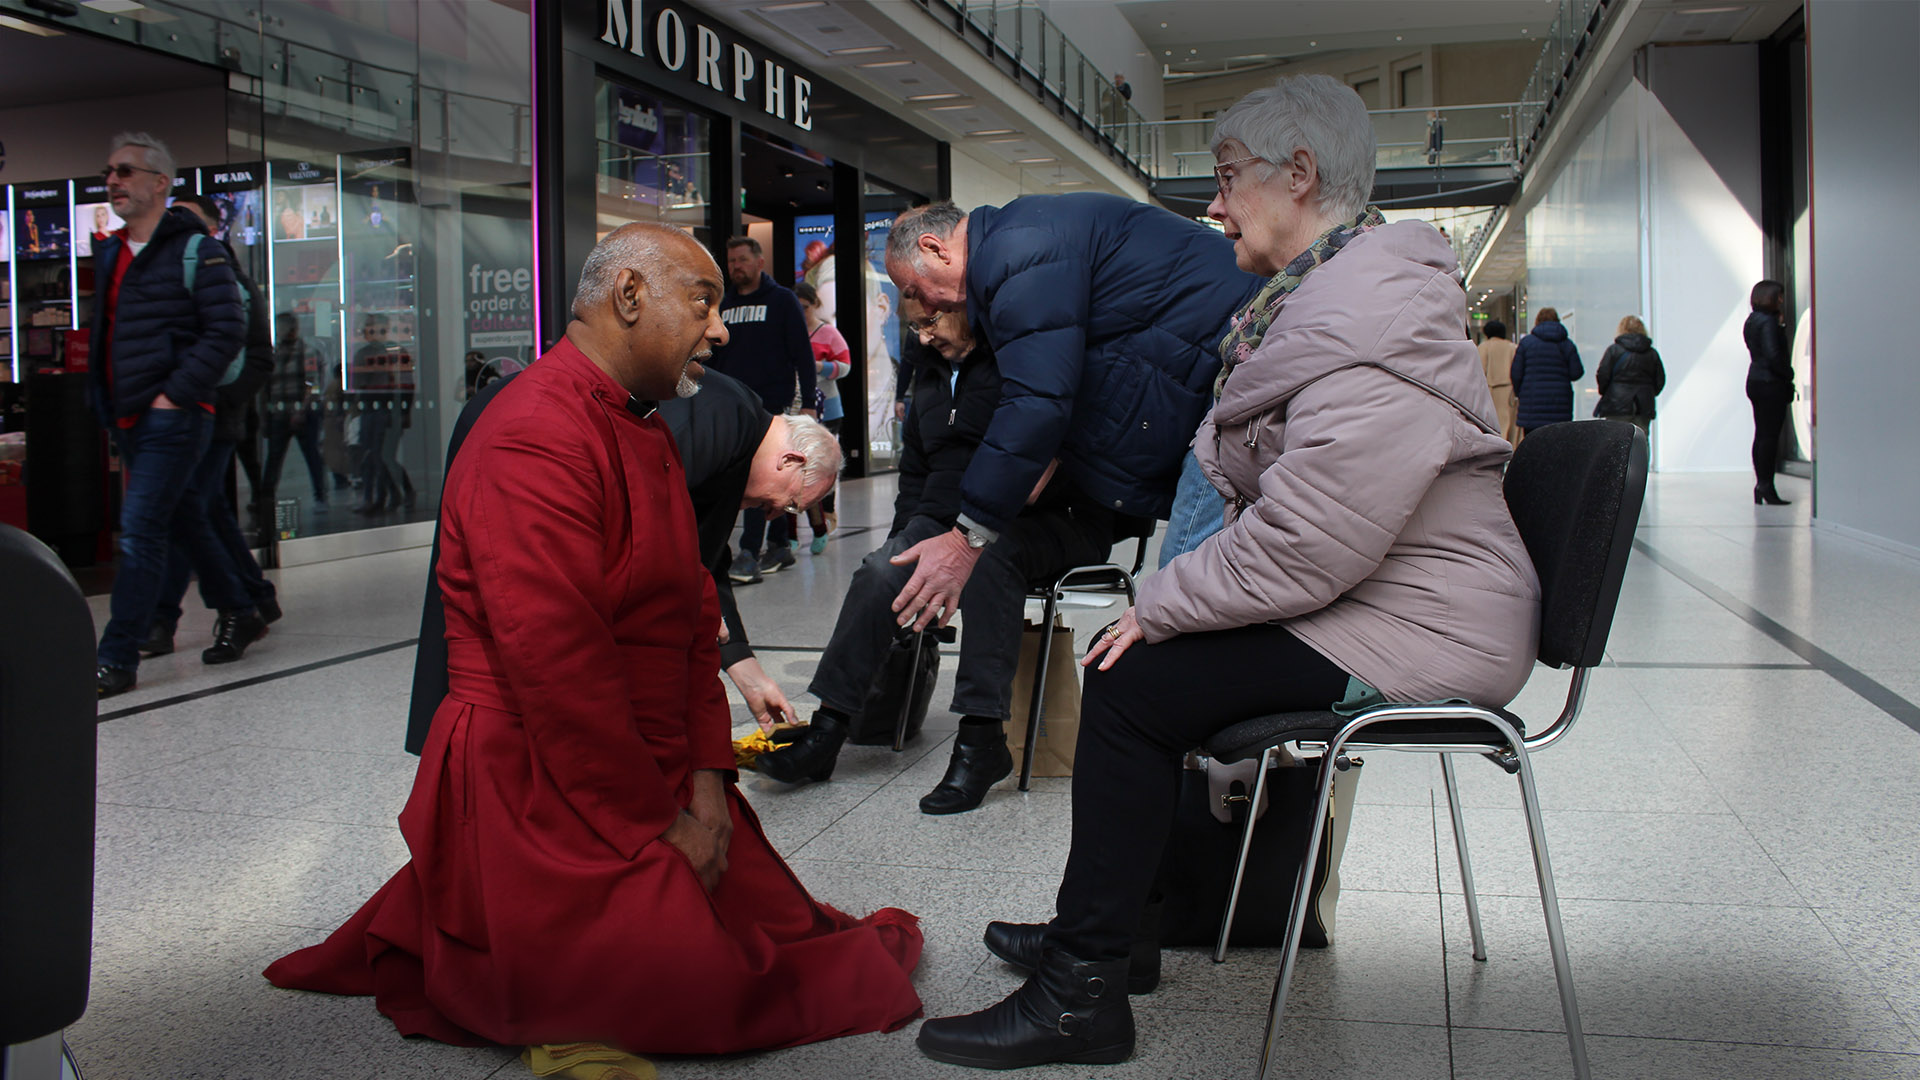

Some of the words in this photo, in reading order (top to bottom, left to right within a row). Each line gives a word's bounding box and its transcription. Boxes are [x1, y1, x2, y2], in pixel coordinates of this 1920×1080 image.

[601, 0, 812, 131] MORPHE
[214, 171, 253, 184] PRADA
[288, 169, 320, 180] VALENTINO
[469, 264, 531, 294] free
[470, 294, 516, 312] order
[519, 293, 530, 310] &
[471, 312, 531, 331] collect
[722, 304, 768, 325] PUMA
